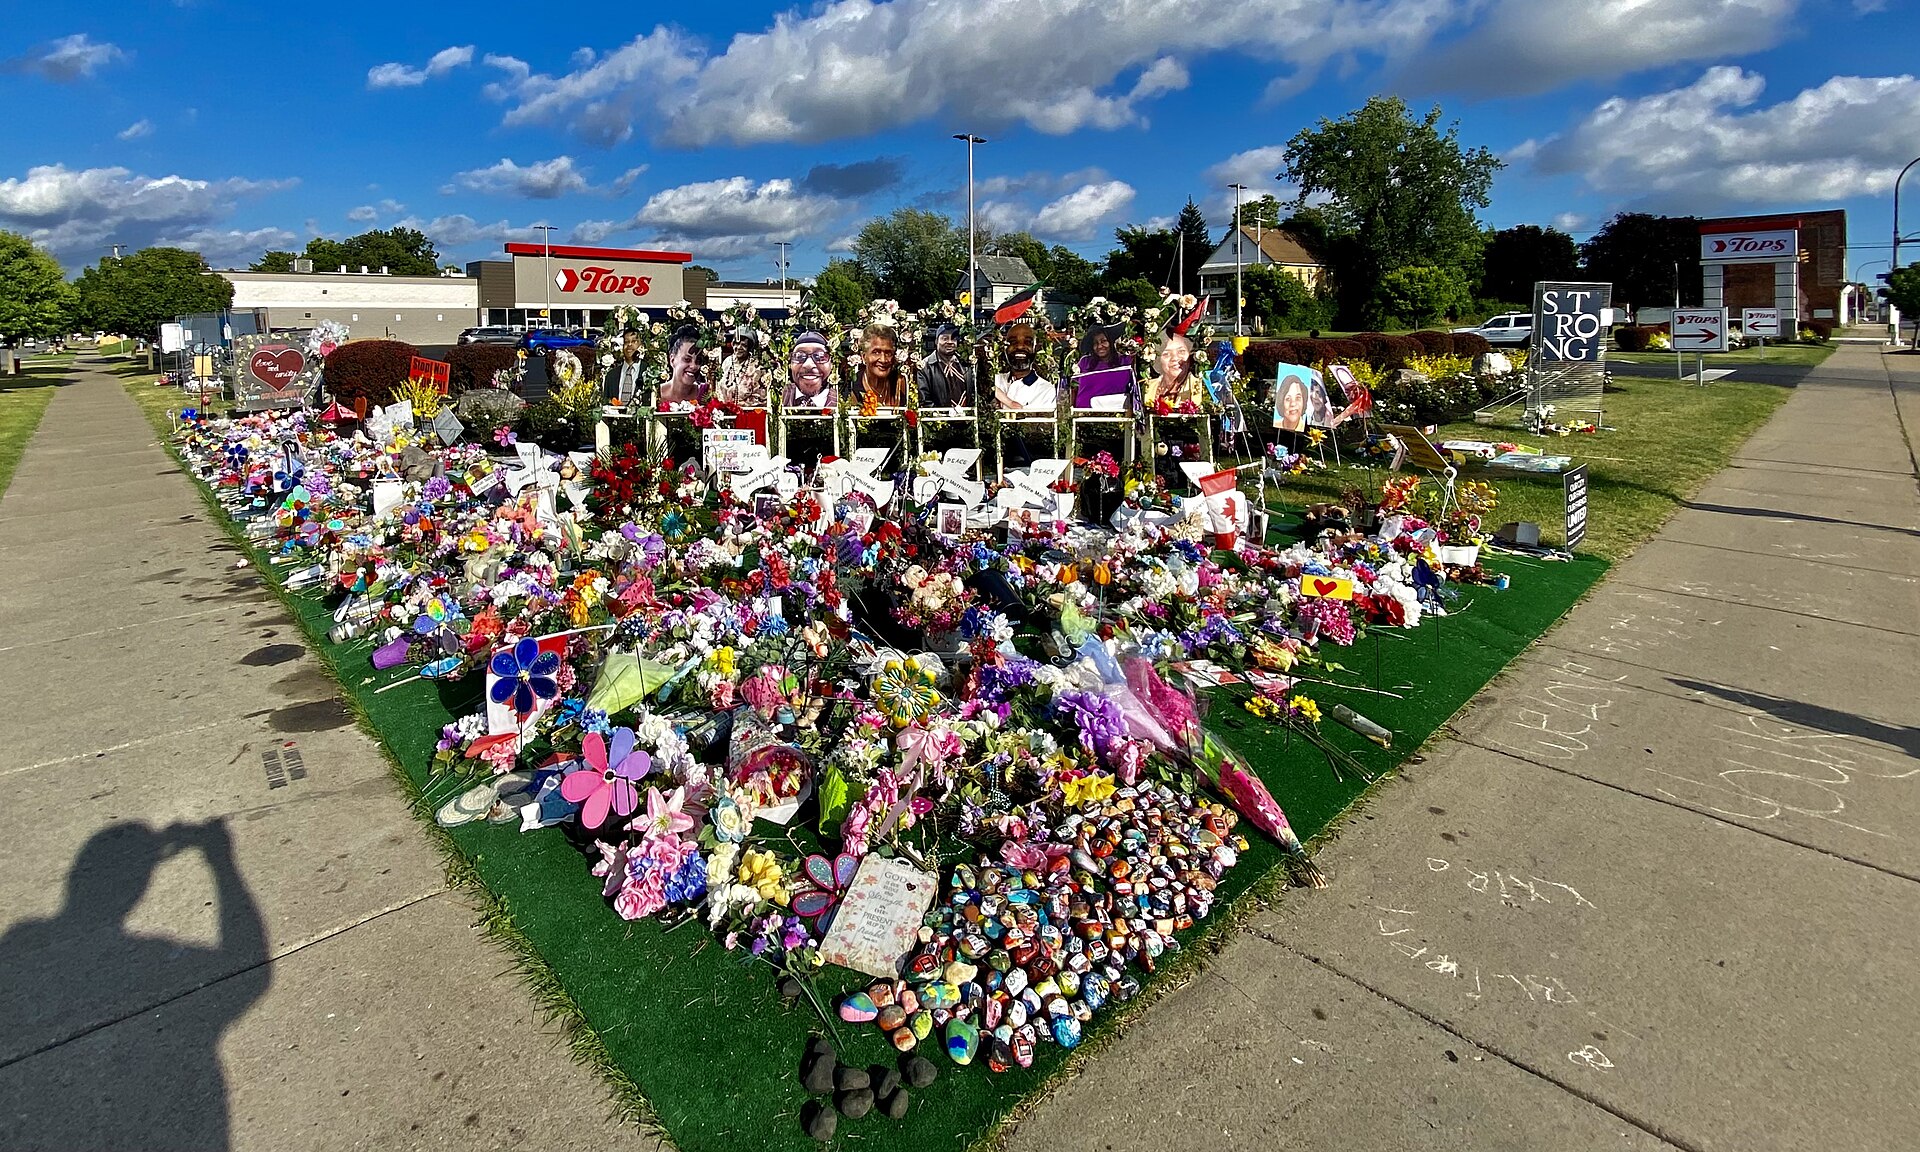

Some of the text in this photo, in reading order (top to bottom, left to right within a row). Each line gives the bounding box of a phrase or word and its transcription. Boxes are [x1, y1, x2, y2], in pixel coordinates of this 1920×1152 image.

[1554, 314, 1599, 338] RO
[1543, 337, 1590, 361] NG
[267, 364, 279, 372] and
[274, 370, 298, 381] unity
[946, 457, 967, 465] PEACE
[949, 479, 972, 495] Morrison
[1567, 506, 1587, 529] UNITED
[884, 871, 908, 884] GOD
[863, 911, 894, 927] PRESENT
